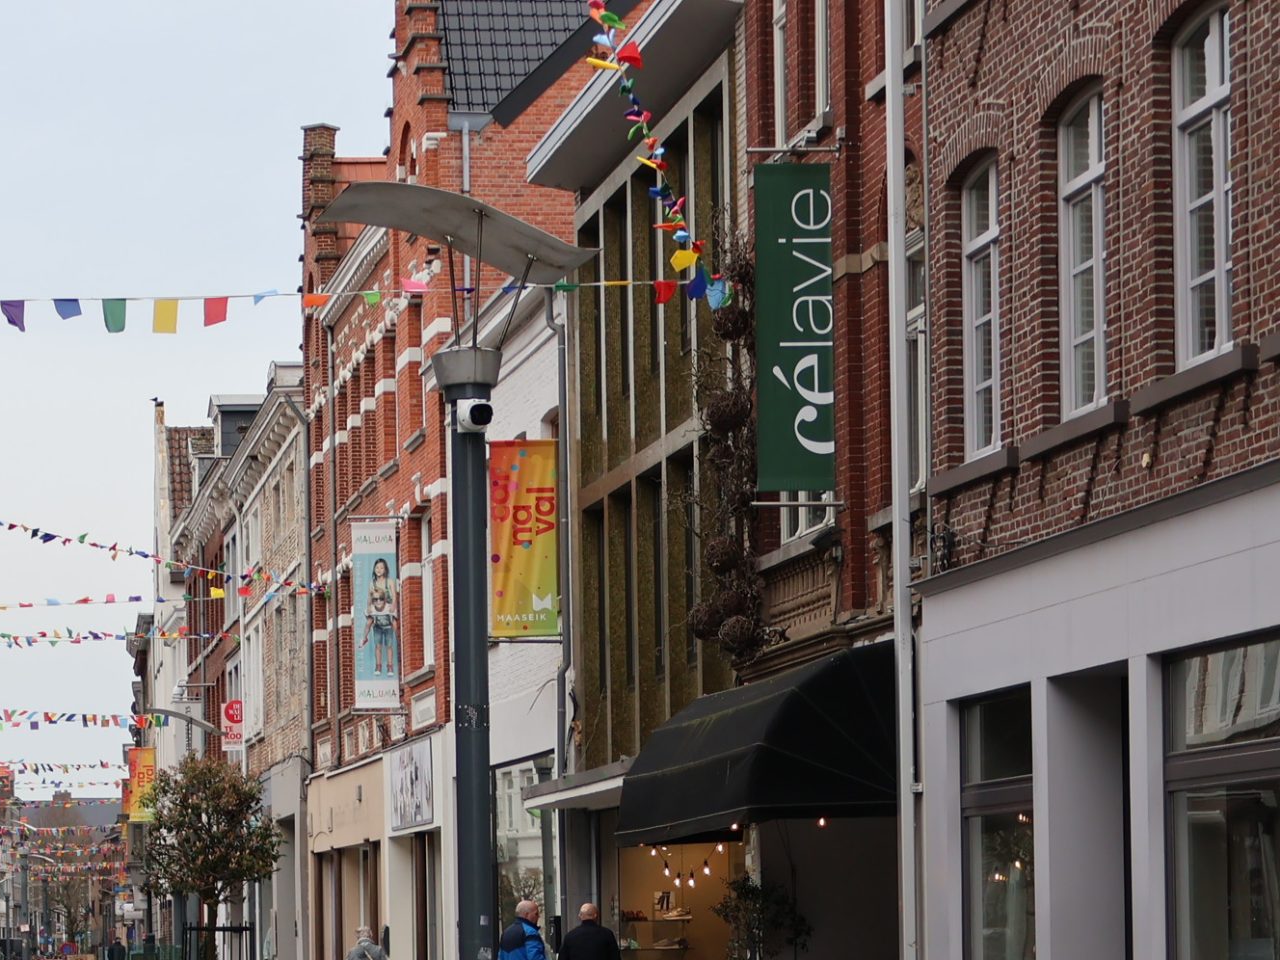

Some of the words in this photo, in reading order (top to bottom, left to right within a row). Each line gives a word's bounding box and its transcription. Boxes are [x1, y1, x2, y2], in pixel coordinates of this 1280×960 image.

[772, 188, 835, 455] célavie
[525, 486, 556, 537] val
[355, 535, 394, 544] MALUMA
[496, 613, 547, 622] MAASEIK
[359, 688, 398, 699] MALUMA
